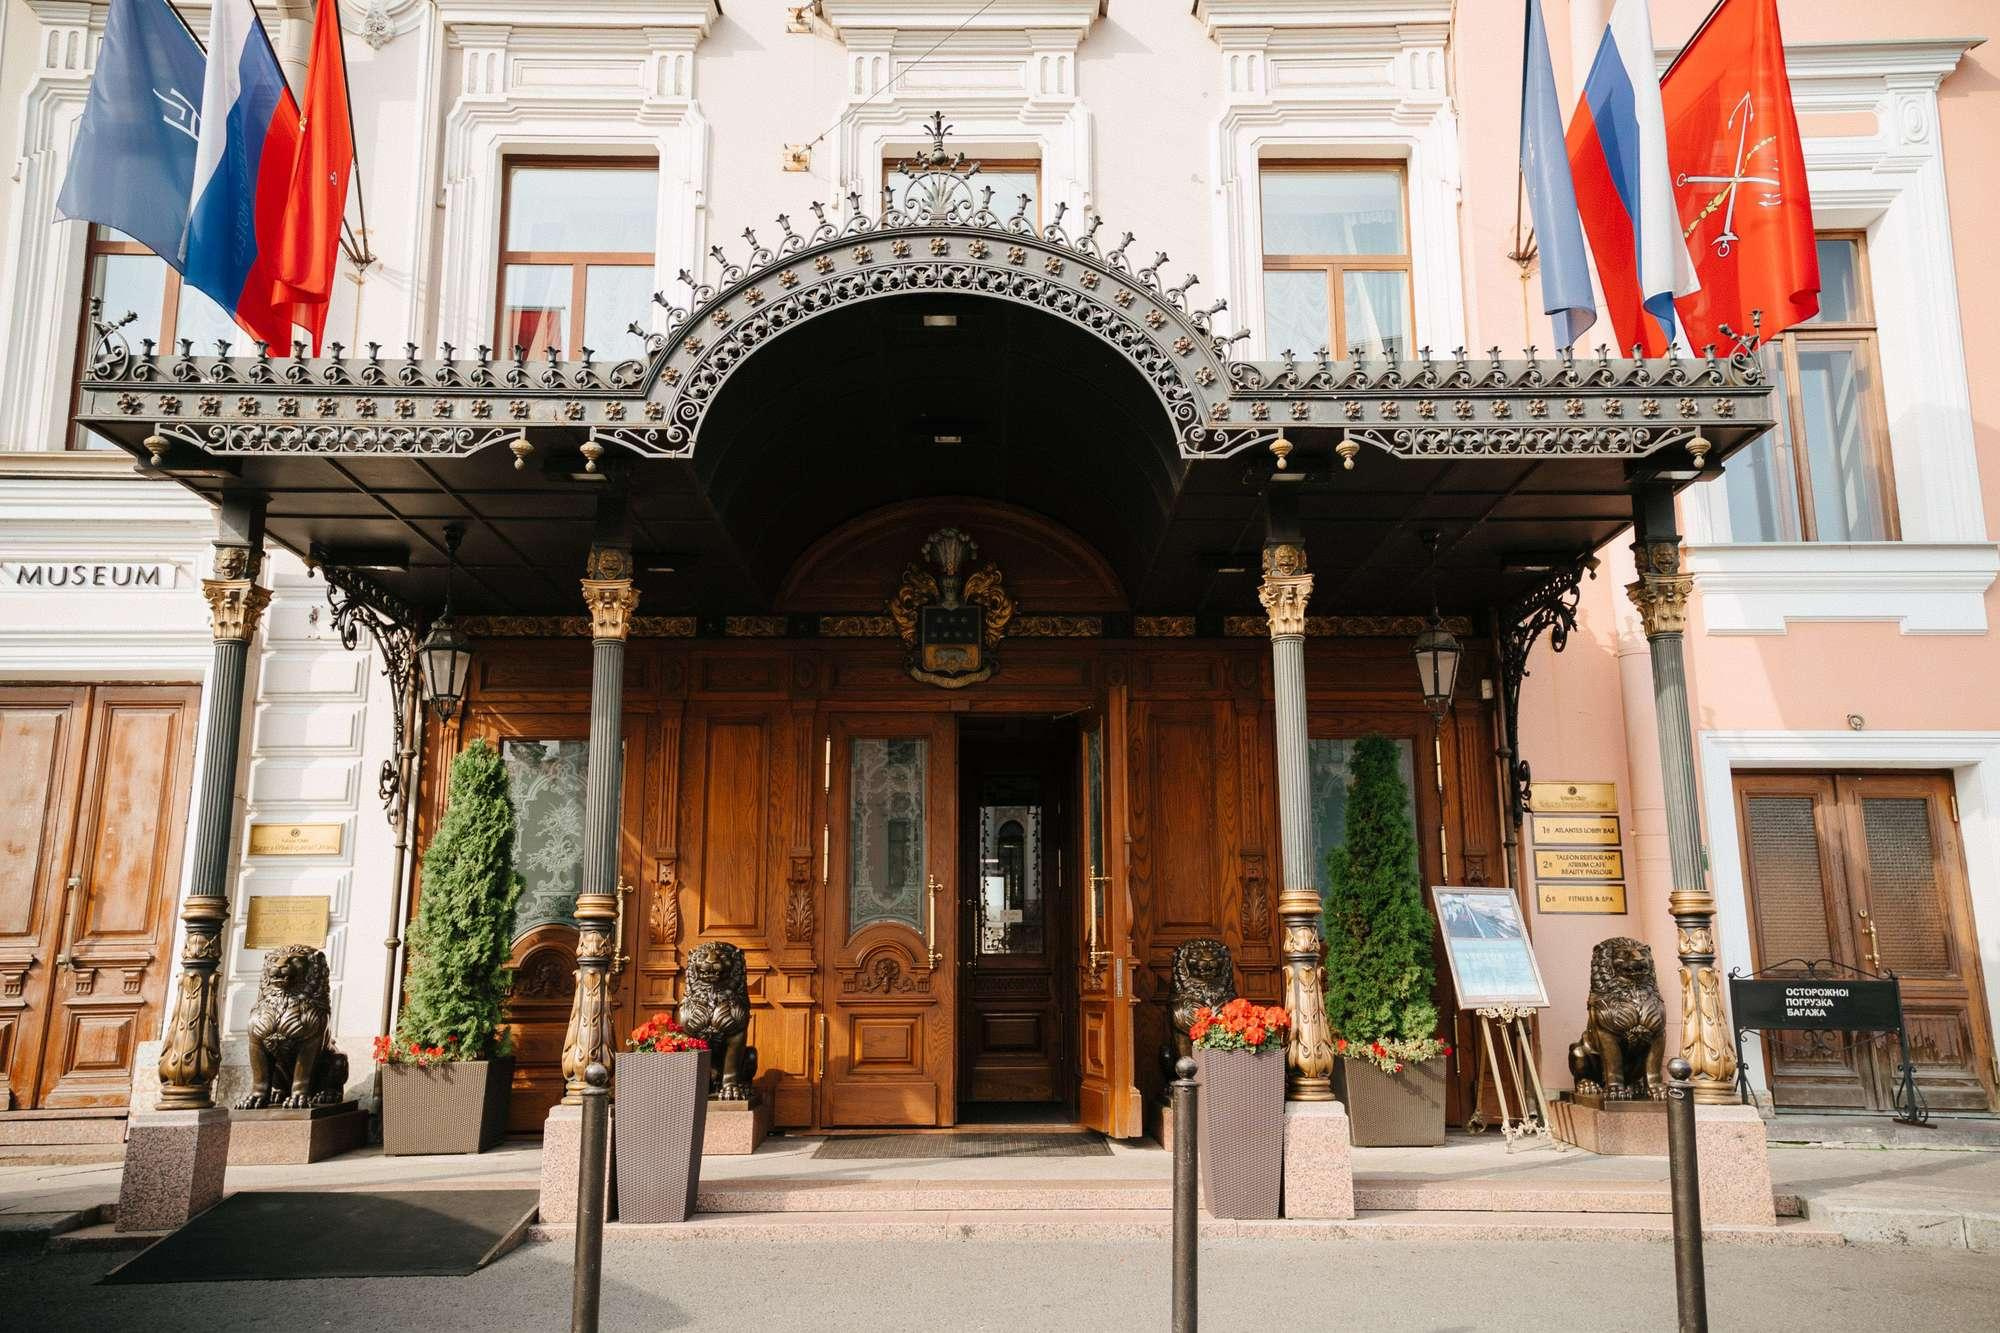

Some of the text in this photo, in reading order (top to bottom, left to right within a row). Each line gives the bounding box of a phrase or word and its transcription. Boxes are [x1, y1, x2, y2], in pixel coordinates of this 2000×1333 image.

[16, 565, 160, 587] MUSEUM
[1603, 826, 1616, 834] BAR
[1785, 988, 1849, 997] ОСТОРОЖНО!
[1785, 998, 1834, 1007] ПОГРУЗКА
[1786, 1008, 1827, 1017] БАГАЖА
